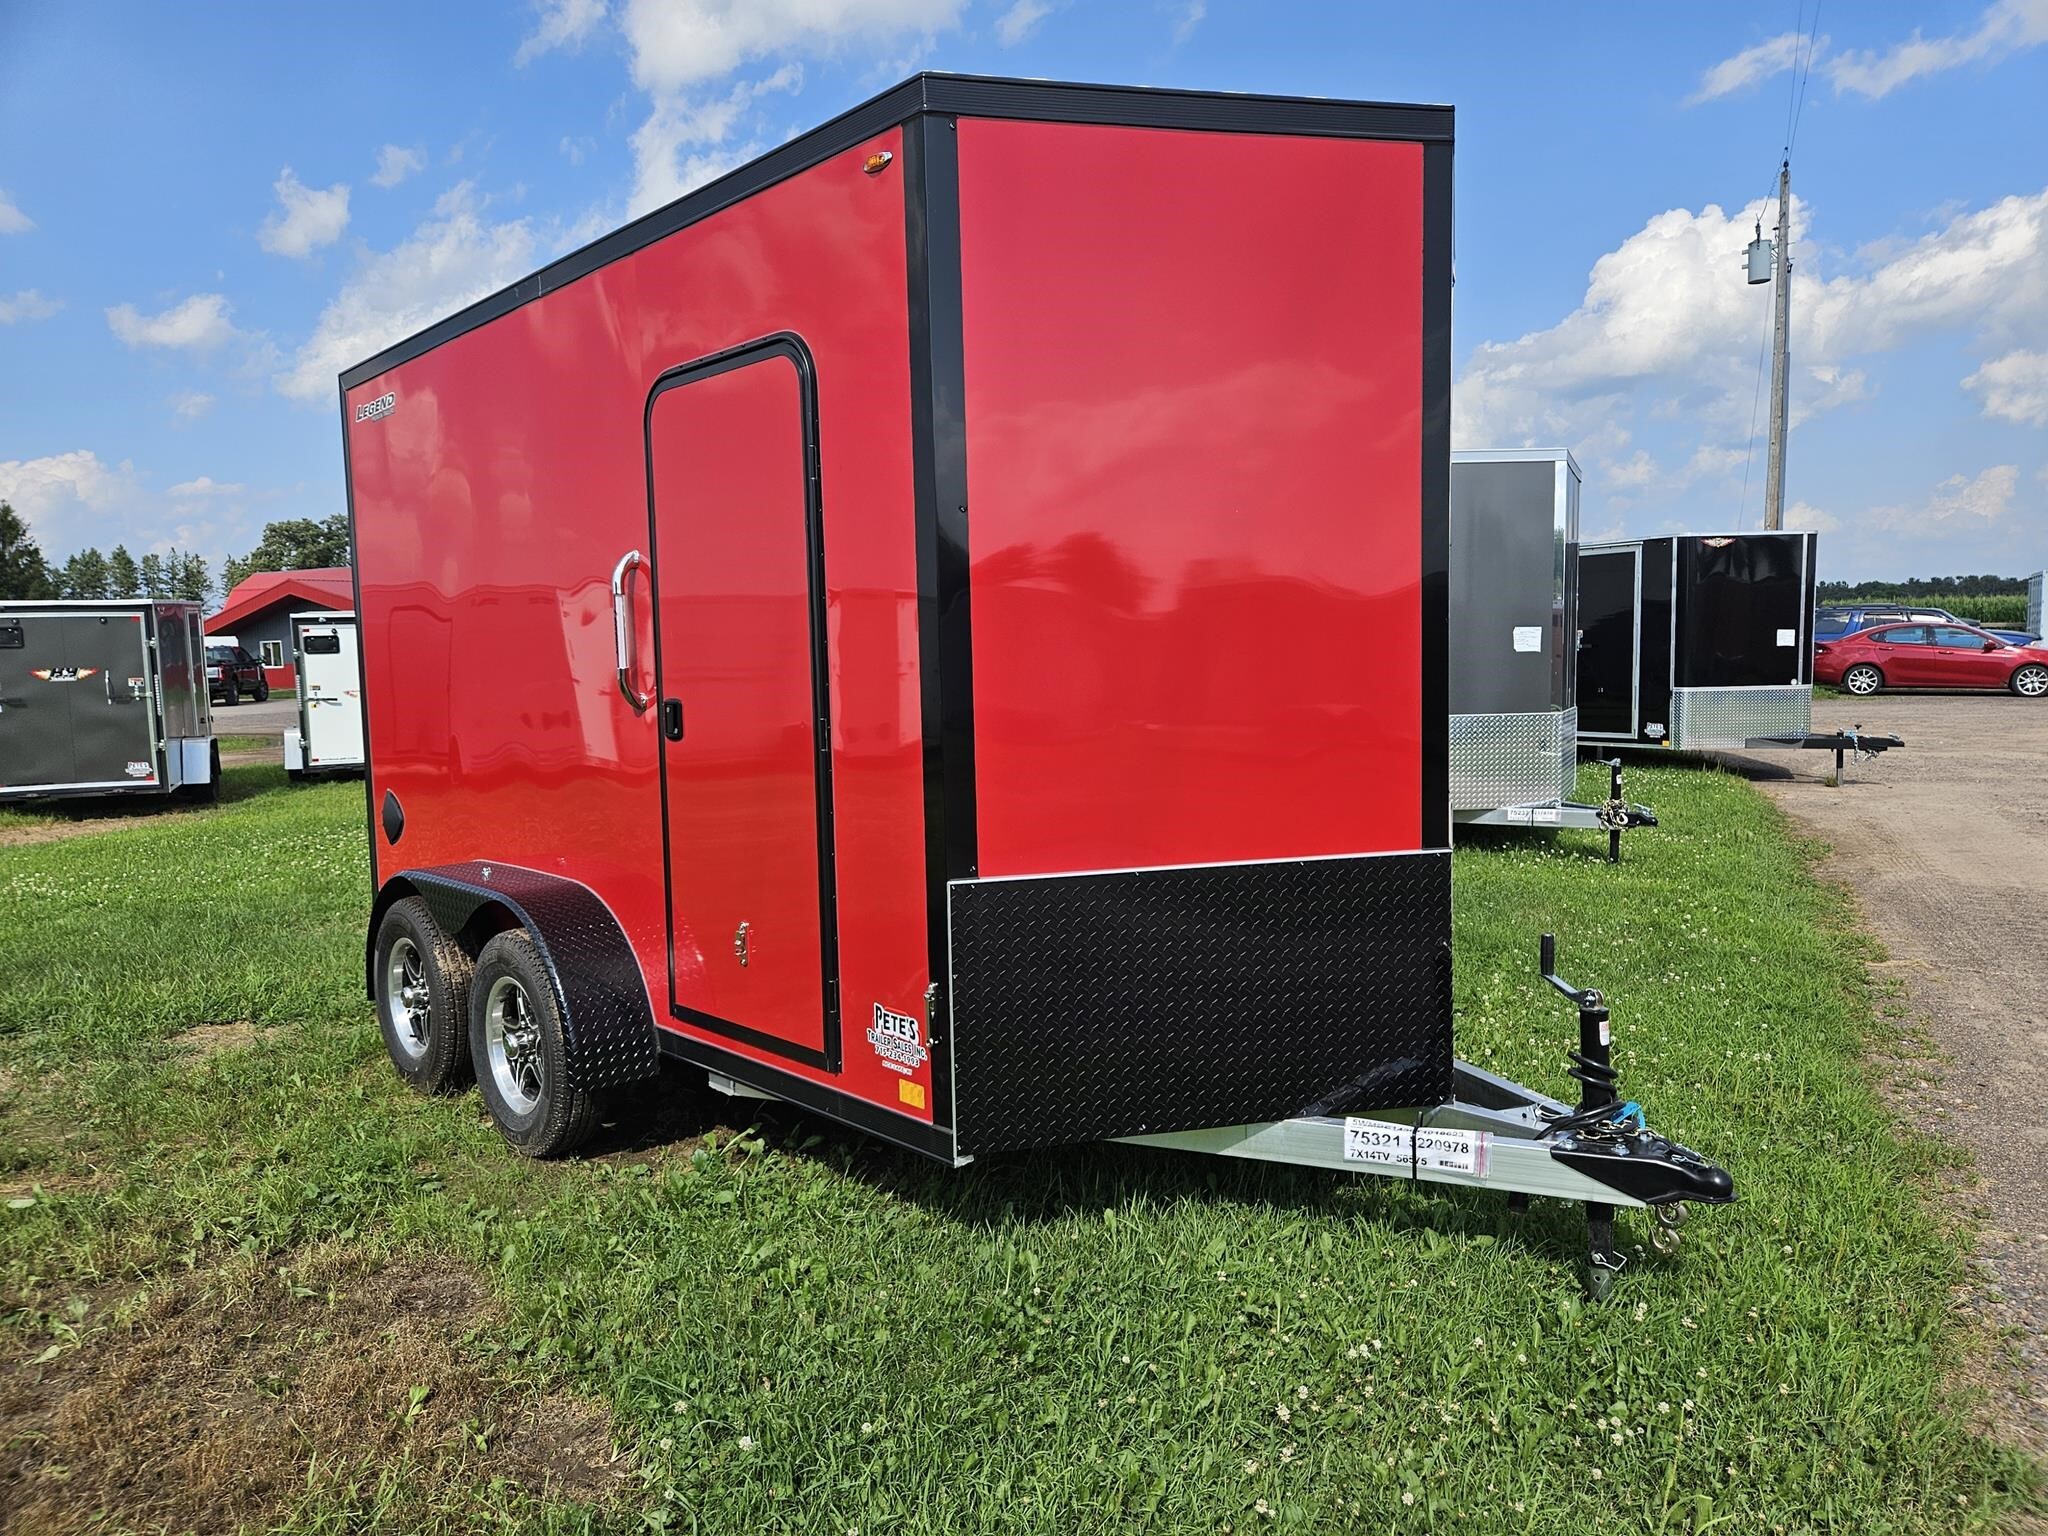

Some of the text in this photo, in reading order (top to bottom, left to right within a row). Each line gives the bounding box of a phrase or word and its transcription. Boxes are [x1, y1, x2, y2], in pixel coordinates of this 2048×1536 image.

[357, 393, 395, 421] LEGEND
[875, 1004, 916, 1041] PETE'S
[867, 1029, 891, 1045] TRAILER
[893, 1038, 912, 1054] SALES
[1350, 1129, 1400, 1148] 75321
[1351, 1148, 1390, 1161] 7X14TV
